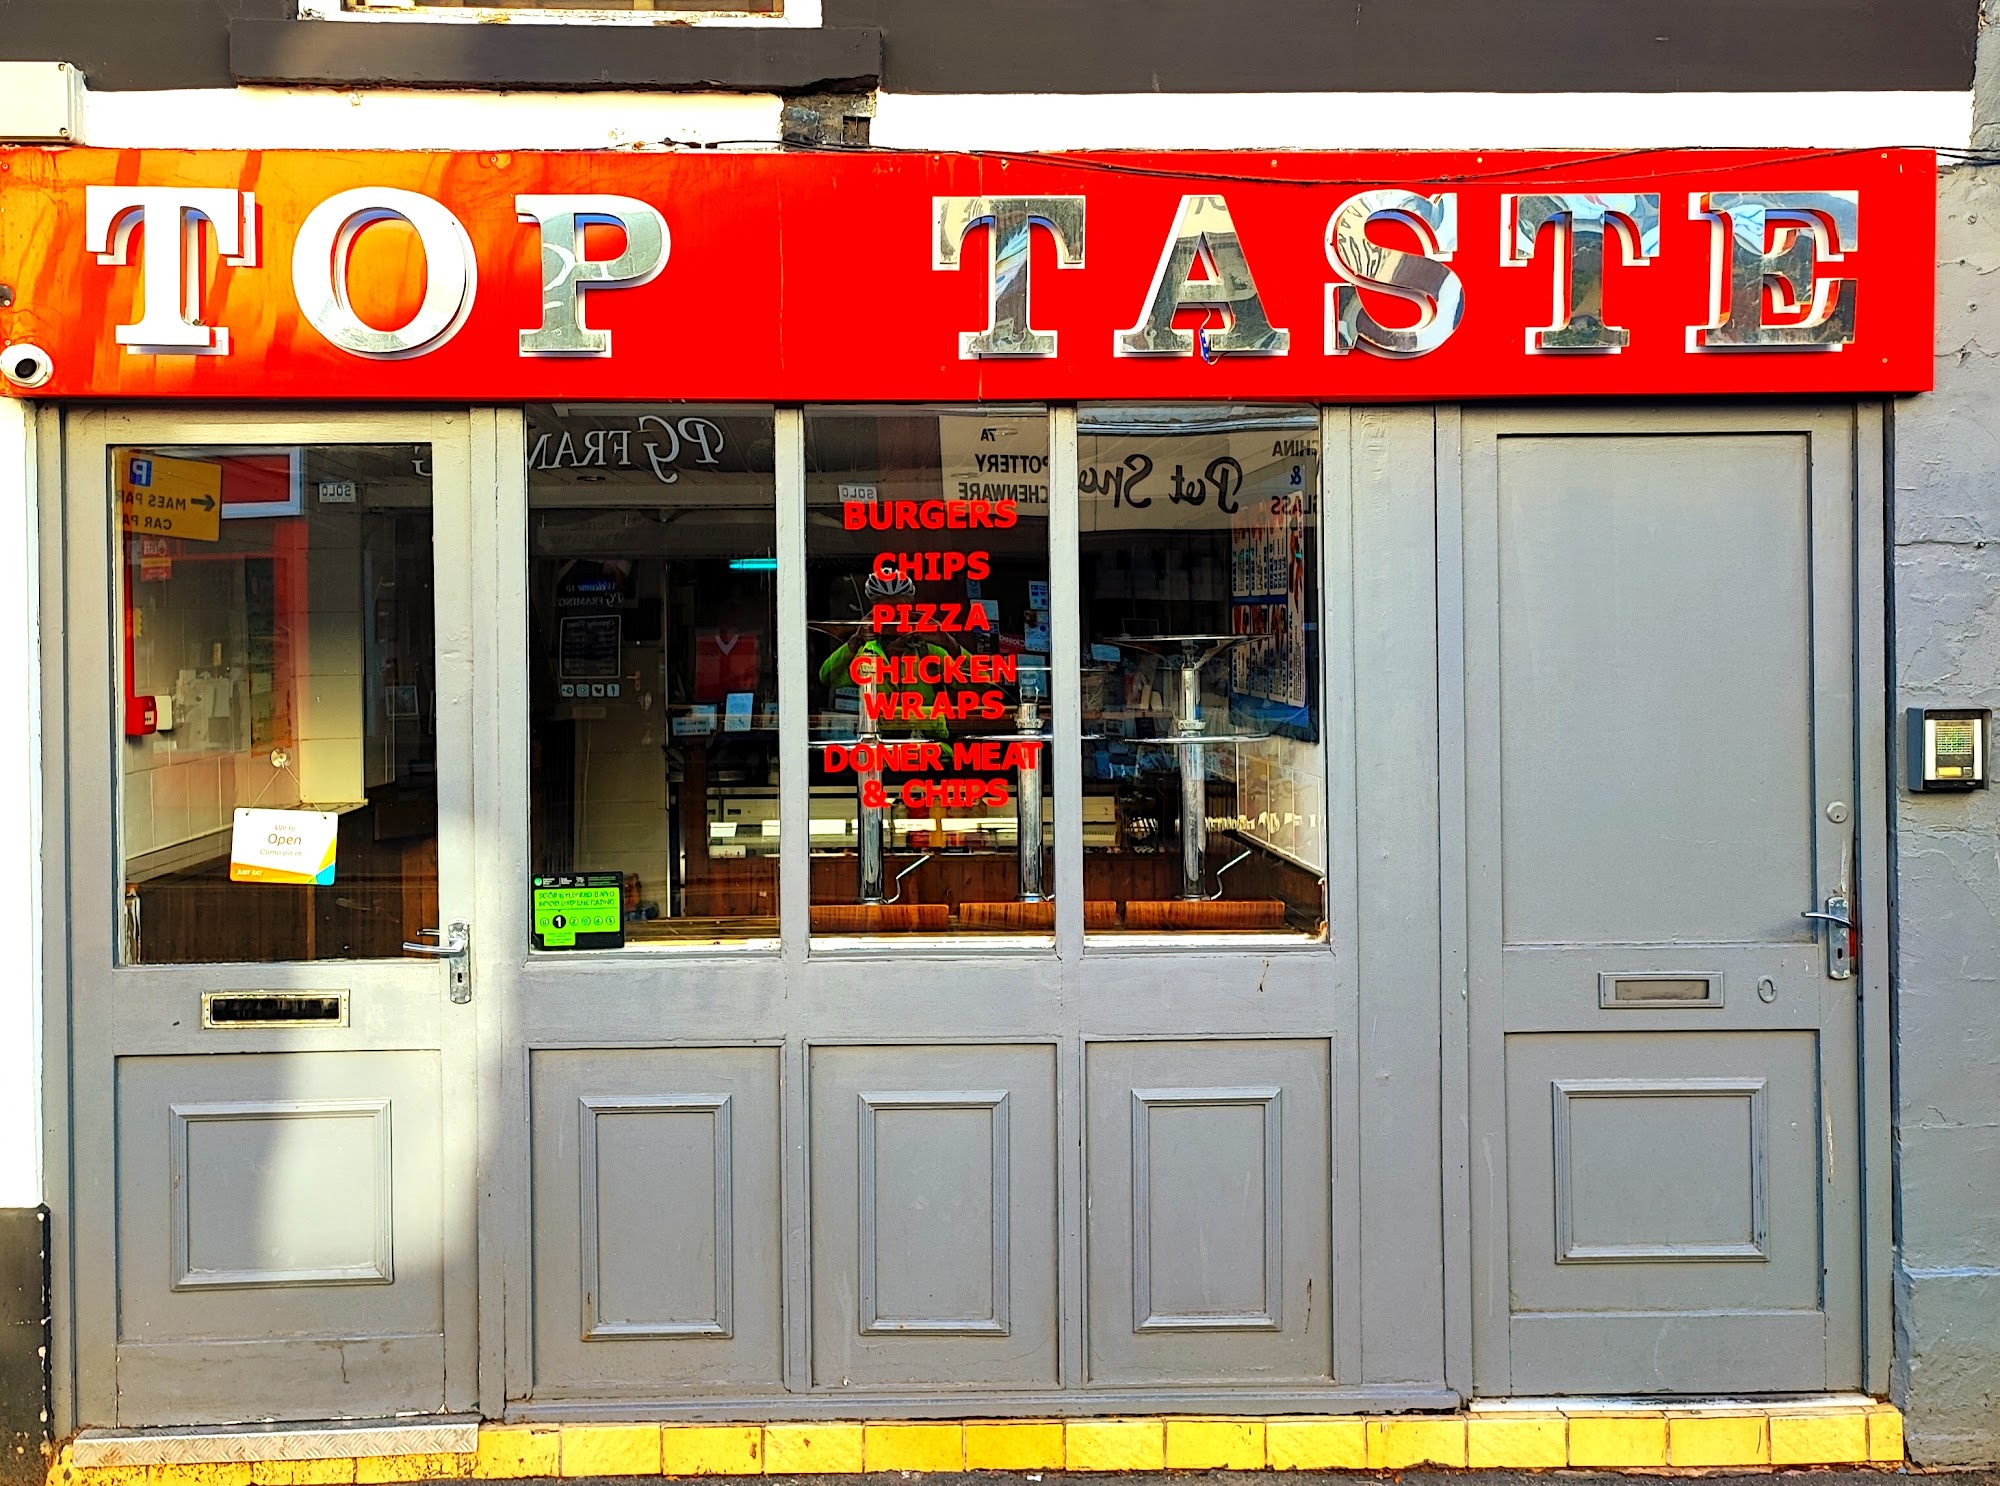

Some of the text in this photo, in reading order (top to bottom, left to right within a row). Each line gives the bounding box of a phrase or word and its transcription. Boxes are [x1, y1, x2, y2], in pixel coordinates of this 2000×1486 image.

[86, 186, 1859, 360] TOP TASTE
[843, 500, 1018, 530] BURGERS
[873, 552, 990, 581] CHIPS
[872, 603, 990, 633] PIZZA
[850, 655, 1017, 685] CHICKEN
[863, 691, 1005, 720] WRAPS
[824, 741, 1043, 773] DONER MEAT
[862, 778, 1010, 808] & CHIPS
[268, 833, 302, 847] Open
[555, 916, 562, 928] 1
